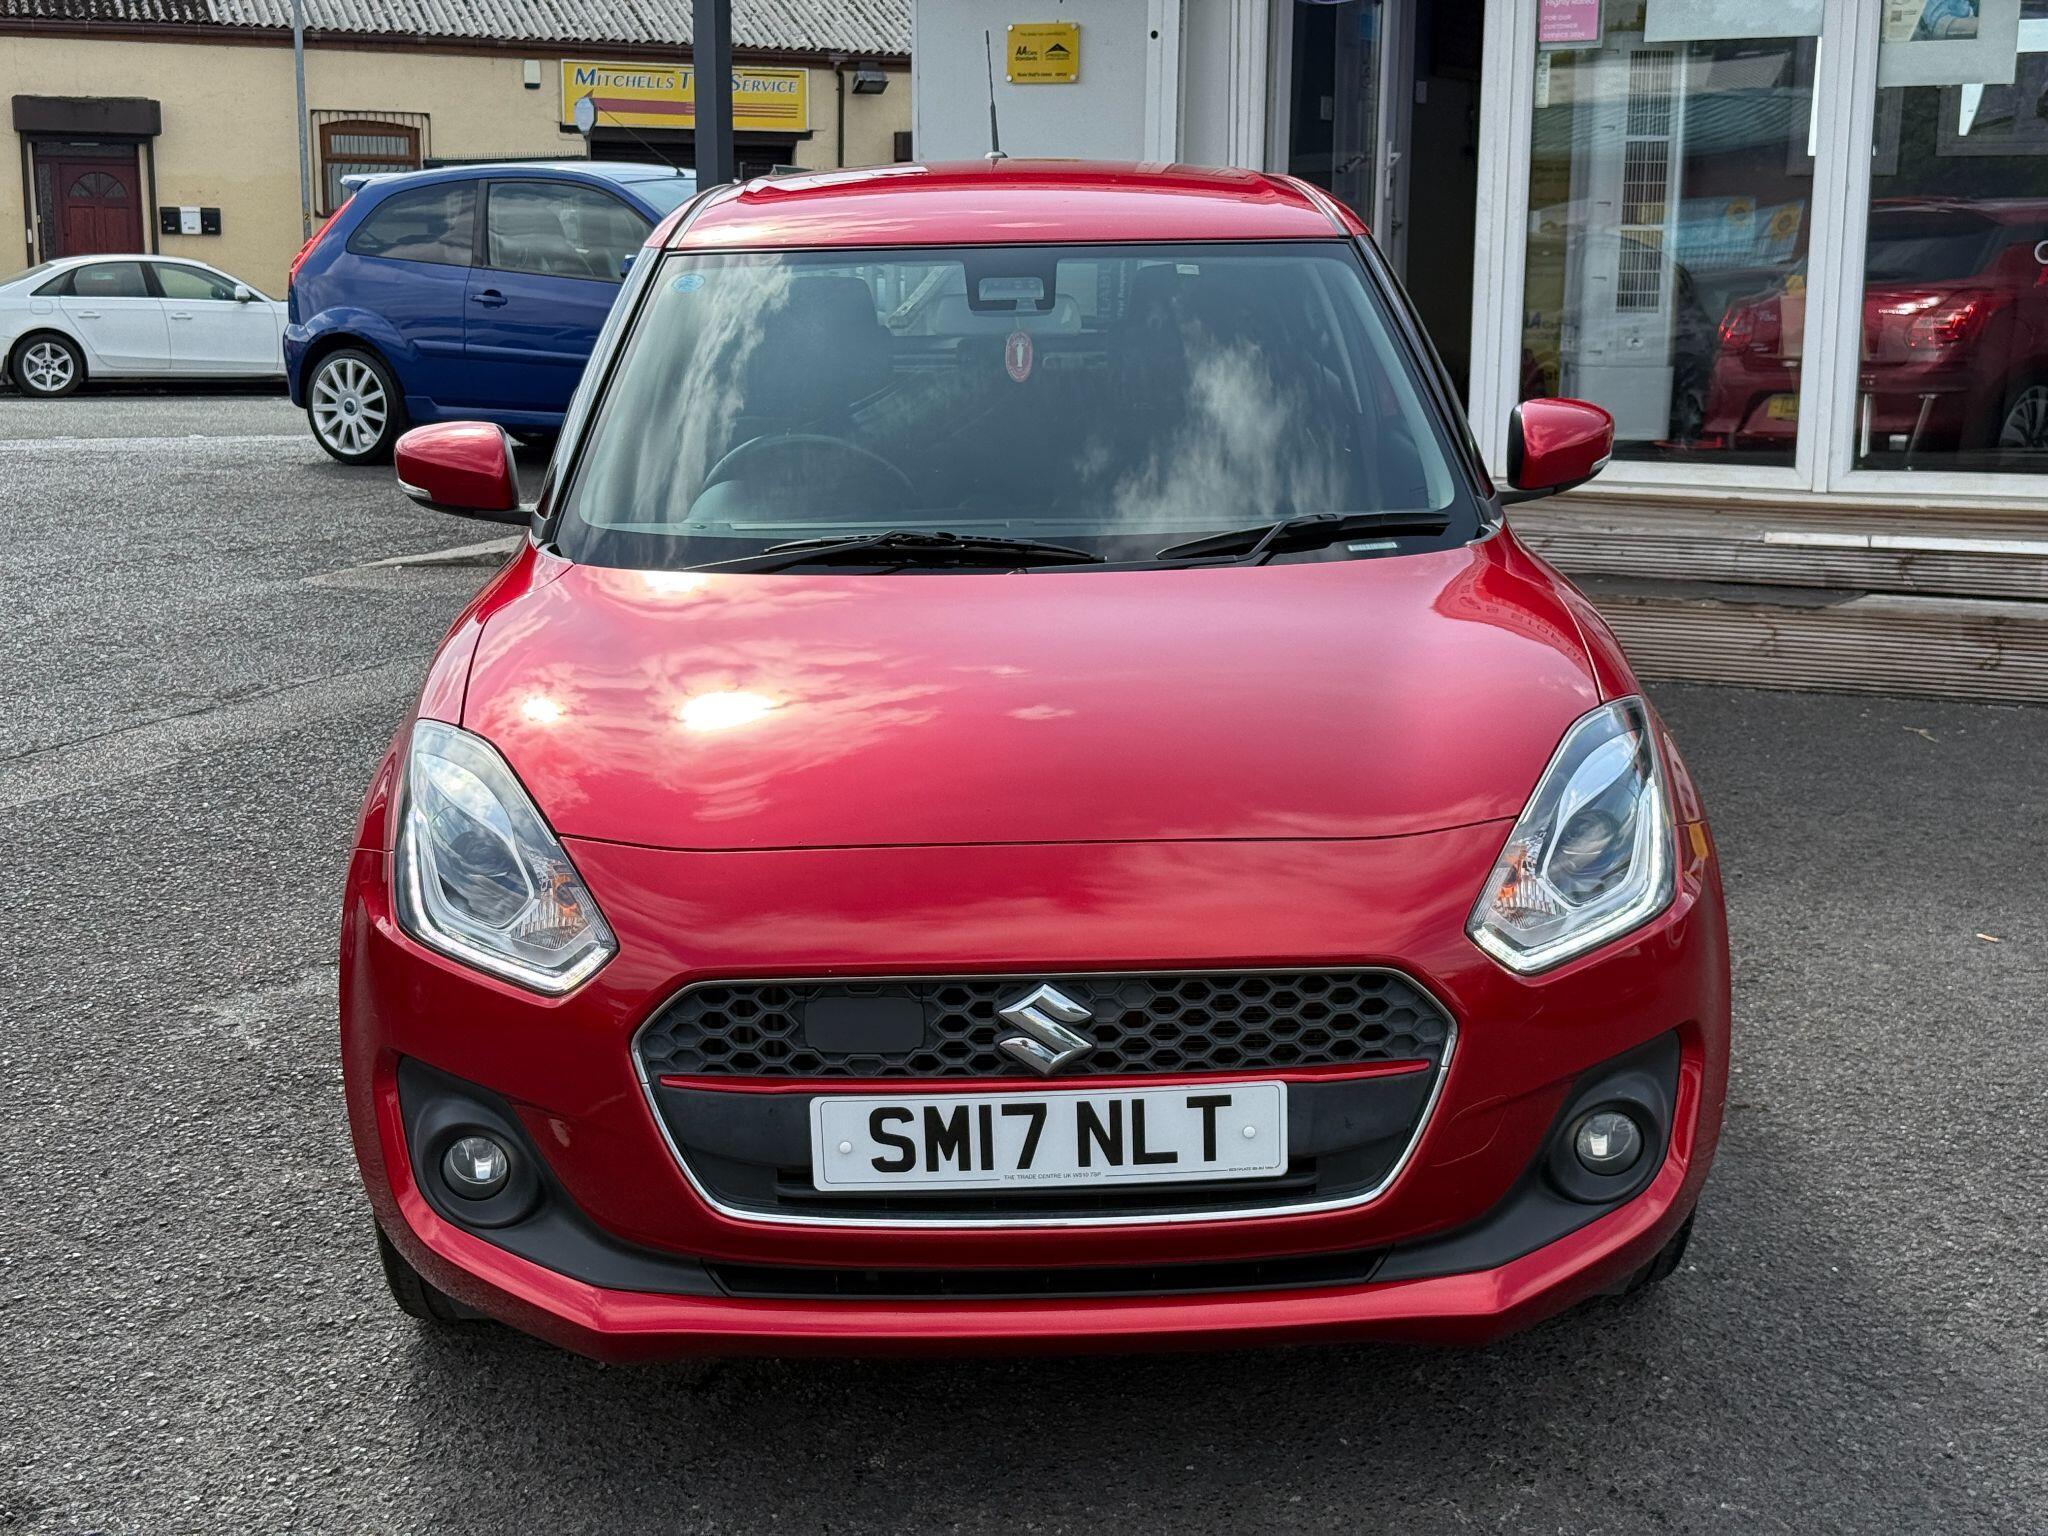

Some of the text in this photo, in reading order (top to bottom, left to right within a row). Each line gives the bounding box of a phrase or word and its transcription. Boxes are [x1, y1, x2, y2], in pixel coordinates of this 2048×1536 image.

[575, 67, 675, 90] MITCHELLS
[731, 73, 798, 94] SERVICE
[869, 1094, 1232, 1173] SM17 NLT
[1037, 1172, 1061, 1180] CENTRE
